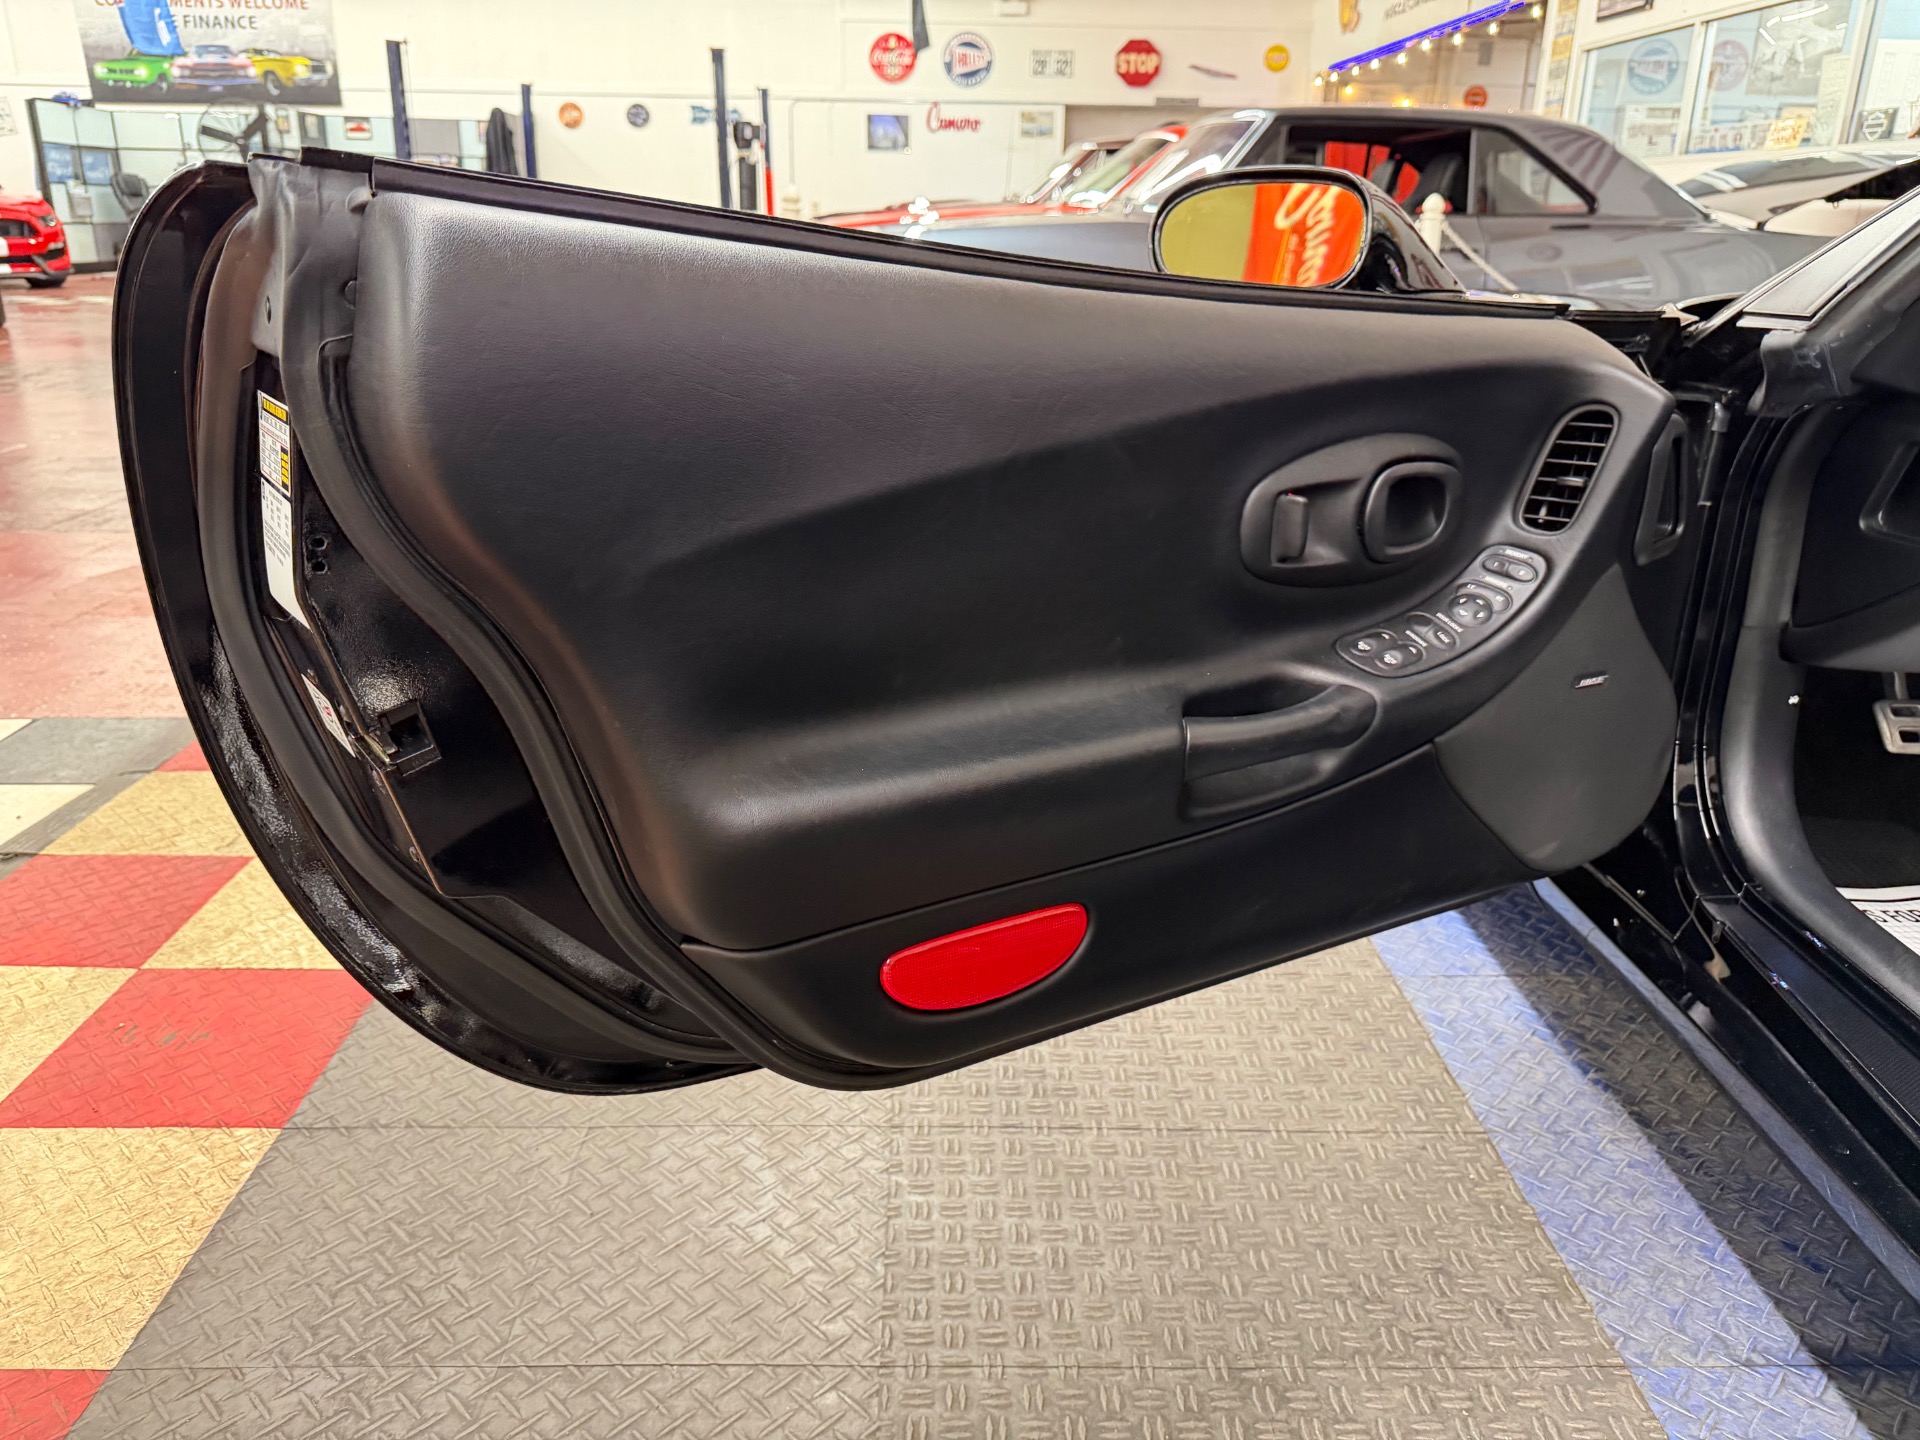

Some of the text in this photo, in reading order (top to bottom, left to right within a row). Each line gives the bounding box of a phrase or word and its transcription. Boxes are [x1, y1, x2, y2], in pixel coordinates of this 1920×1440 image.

[230, 0, 309, 10] WELCOME
[183, 15, 258, 30] FINANCE
[1117, 51, 1160, 75] STOP
[926, 101, 982, 133] Camaro
